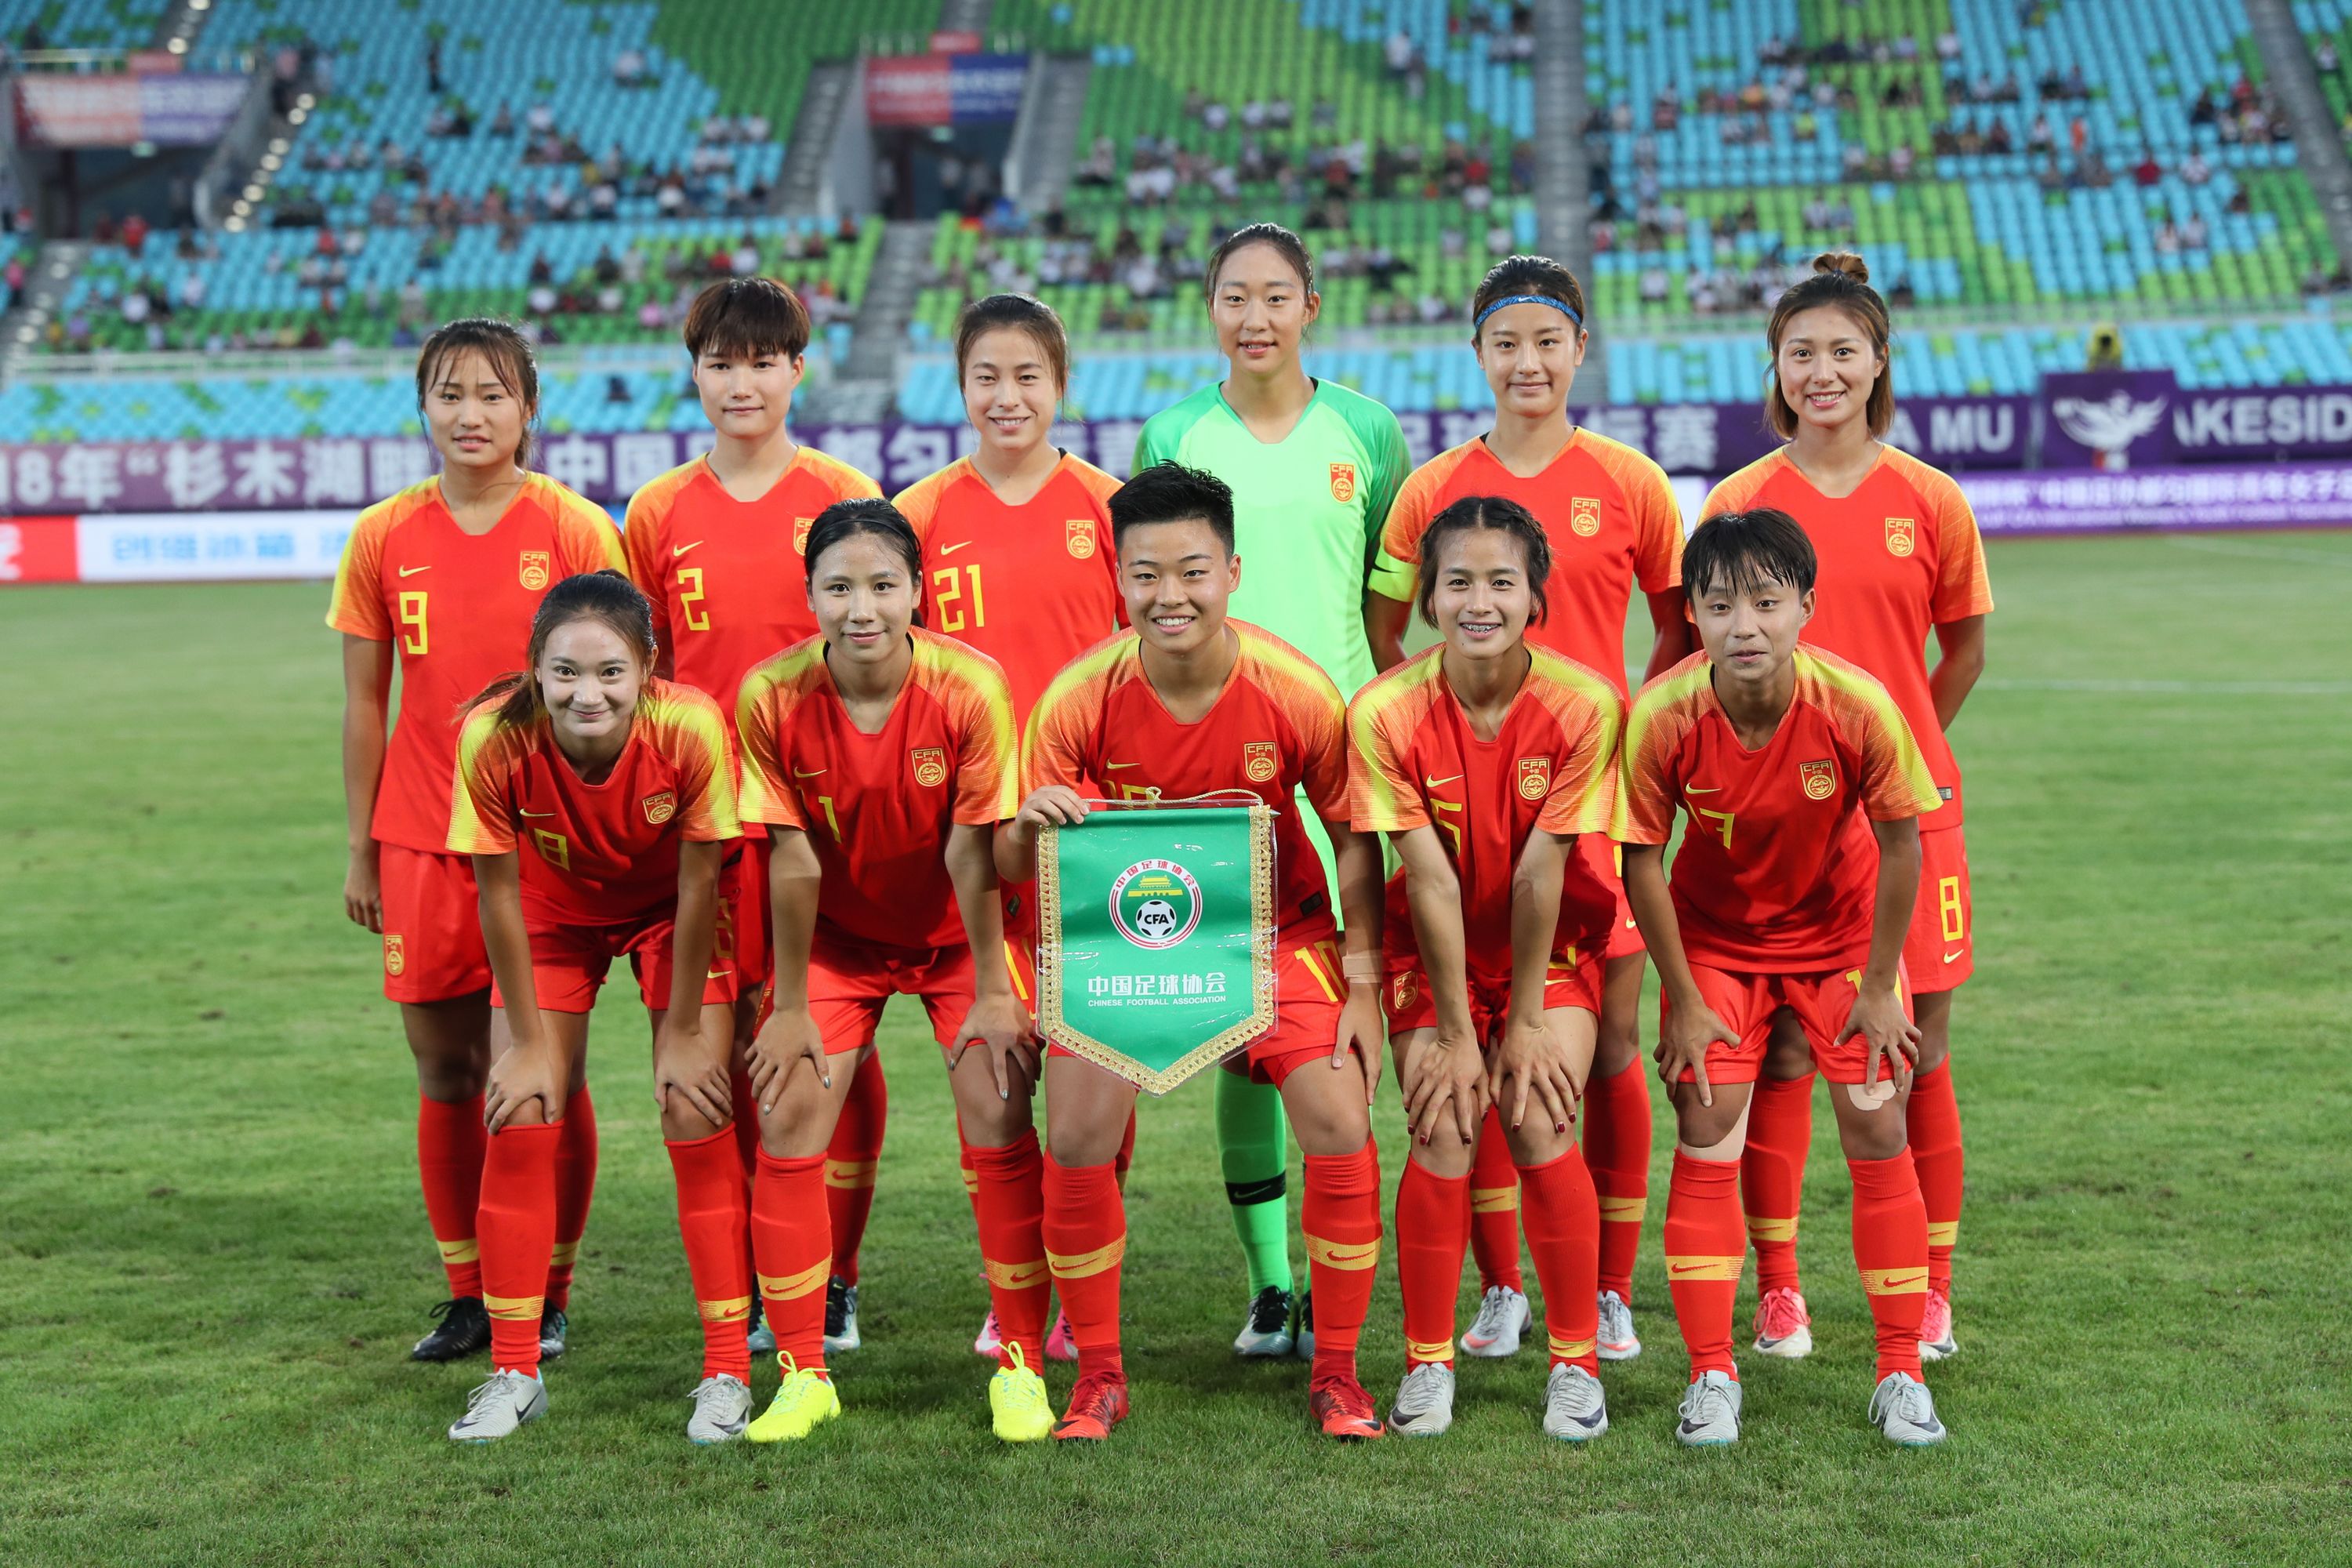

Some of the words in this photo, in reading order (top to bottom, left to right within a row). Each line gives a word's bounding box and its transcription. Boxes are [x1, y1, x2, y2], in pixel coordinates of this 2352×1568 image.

[1930, 404, 2015, 454] MU
[1331, 464, 1353, 474] CFA
[1574, 500, 1598, 510] CFA
[1888, 521, 1911, 529] CFA
[677, 568, 710, 631] 2
[933, 564, 985, 633] 21
[398, 591, 428, 655] 9
[1247, 744, 1273, 753] CFA
[914, 750, 940, 759] CFA
[1522, 760, 1547, 770] CFA
[1803, 762, 1829, 772] CFA
[1429, 797, 1463, 858] 5
[1116, 860, 1195, 889] 中国足球协会
[1939, 876, 1964, 942] 8
[1144, 913, 1169, 924] CFA
[1087, 971, 1226, 997] 中国足球协会
[1087, 999, 1123, 1007] CHINESE
[1172, 996, 1226, 1005] ASSOCIATION
